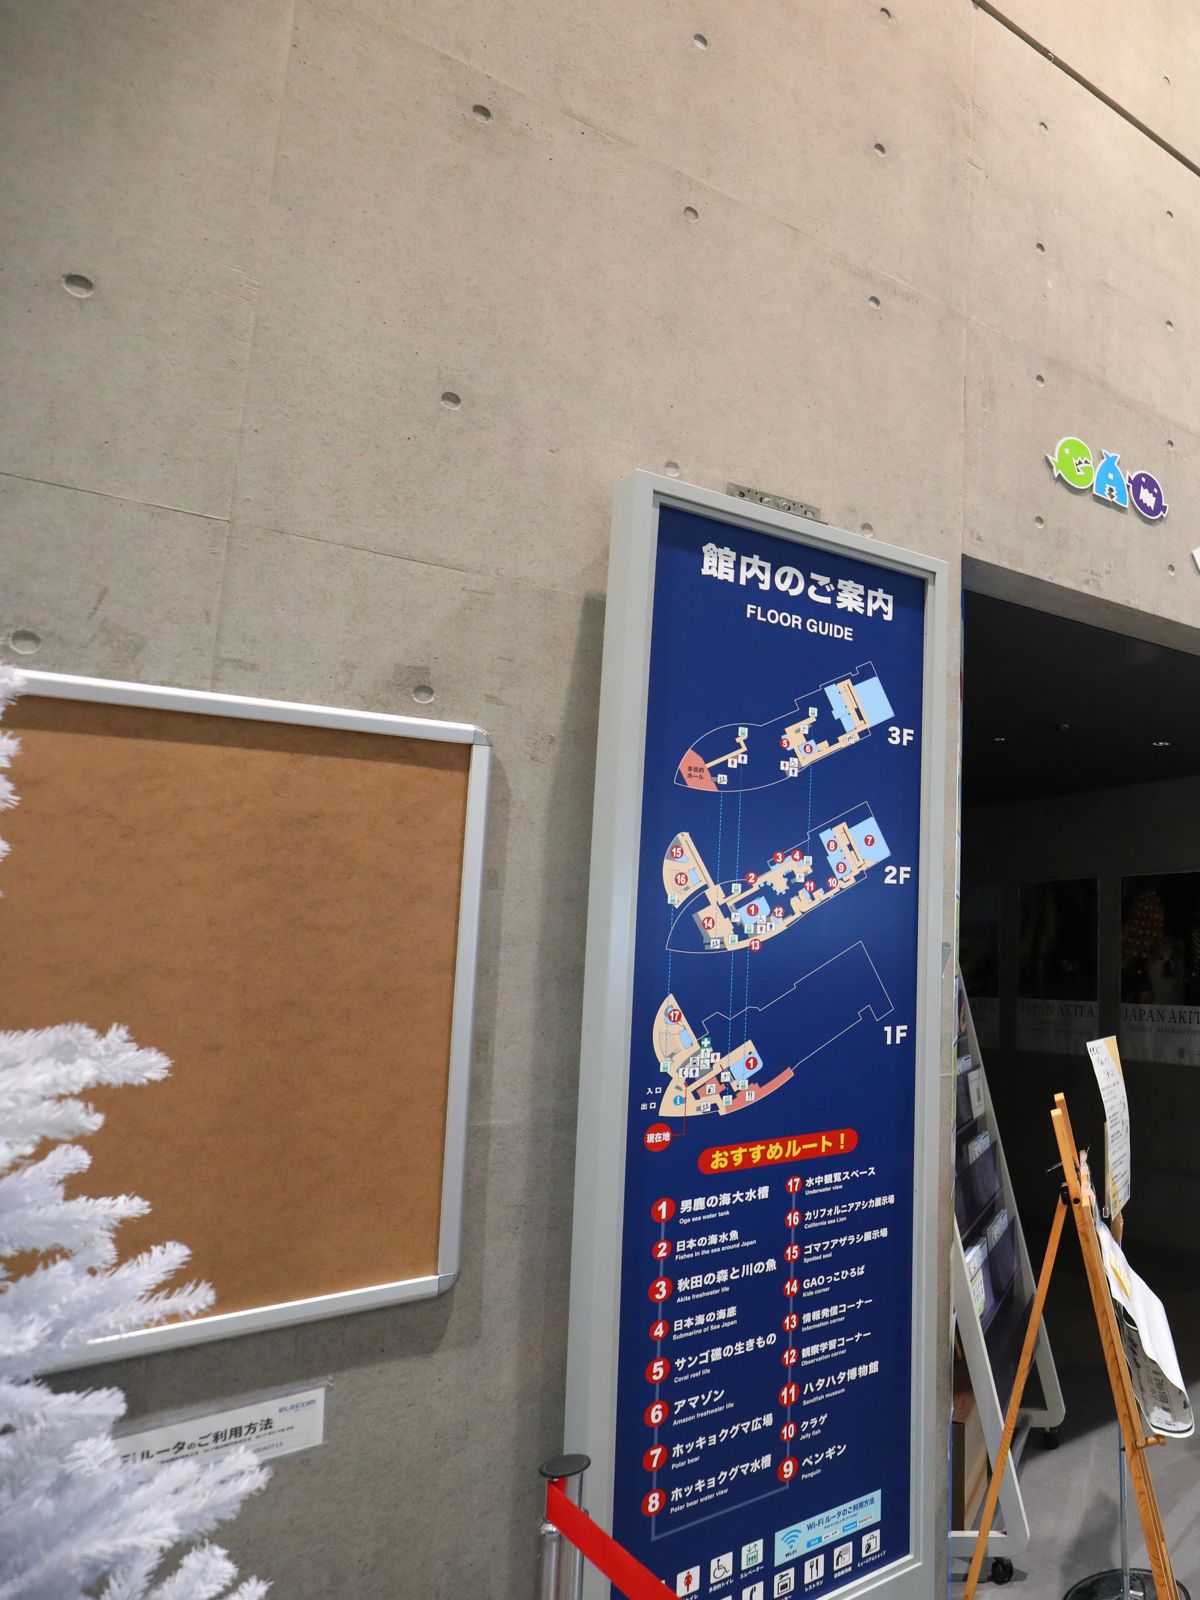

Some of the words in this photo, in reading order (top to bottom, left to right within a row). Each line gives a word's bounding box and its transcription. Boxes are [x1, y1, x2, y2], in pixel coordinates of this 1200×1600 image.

[701, 542, 894, 621] 館内のご案内
[746, 604, 802, 630] FLOOR
[806, 619, 853, 641] GUIDE
[887, 726, 914, 746] 3F
[884, 866, 911, 884] 2F
[1057, 1003, 1095, 1018] AKITA
[1124, 1008, 1165, 1022] JAPAN
[884, 1025, 908, 1045] 1F
[646, 1087, 662, 1095] 入口
[640, 1102, 656, 1110] 出口
[646, 1131, 671, 1144] 現在地
[710, 1134, 846, 1170] おすすめルート！
[787, 1178, 800, 1192] 17
[805, 1167, 876, 1188] 水中観覧スペース
[658, 1201, 667, 1219] 1
[680, 1185, 770, 1214] 男鹿の海大水槽
[805, 1187, 831, 1196] Underwater
[679, 1217, 691, 1225] Oga
[702, 1212, 717, 1220] water
[718, 1210, 730, 1218] tank
[787, 1212, 799, 1226] 16
[804, 1194, 895, 1222] カリフォルニアアシカ展示場
[804, 1221, 827, 1229] California
[657, 1242, 667, 1258] 2
[676, 1230, 739, 1252] 日本の海水魚
[675, 1253, 694, 1261] Fishes
[721, 1243, 740, 1252] around
[741, 1239, 757, 1249] Japan
[786, 1246, 799, 1260] 15
[804, 1227, 888, 1255] ゴマフアザラシ展示場
[803, 1254, 822, 1264] Spotted
[655, 1280, 667, 1300] 3
[677, 1258, 777, 1293] 秋田の森と川の魚
[785, 1280, 798, 1295] 14
[803, 1264, 866, 1289] GAOっこひろば
[677, 1295, 691, 1303] Akita
[691, 1289, 720, 1300] freshwater
[814, 1286, 831, 1295] corner
[654, 1322, 664, 1338] 4
[673, 1306, 737, 1332] 日本海の海底
[784, 1315, 797, 1330] 13
[802, 1298, 873, 1324] 情報発信コーナー
[801, 1320, 829, 1332] Information
[830, 1316, 845, 1325] corner
[672, 1329, 702, 1341] Submarine
[721, 1319, 737, 1330] Japan
[652, 1361, 664, 1381] 5
[675, 1333, 777, 1372] サンゴ礁の生きもの
[783, 1349, 796, 1365] 12
[801, 1331, 872, 1359] 観察学習コーナー
[801, 1354, 830, 1367] Observation
[831, 1349, 847, 1358] corner
[674, 1374, 689, 1384] Coral
[690, 1371, 701, 1379] reef
[702, 1368, 711, 1376] life
[781, 1385, 796, 1405] 11
[803, 1361, 880, 1395] ハタハタ博物館
[278, 1399, 316, 1413] ELECOM
[651, 1404, 663, 1424] 6
[674, 1389, 725, 1415] アマゾン
[803, 1395, 825, 1406] Sandfish
[825, 1387, 846, 1399] museum
[672, 1414, 695, 1426] Amazon
[696, 1406, 725, 1419] freshwater
[725, 1402, 734, 1410] life
[782, 1424, 795, 1440] 10
[800, 1413, 828, 1432] クラゲ
[799, 1431, 812, 1441] Jelly
[812, 1429, 821, 1437] fish
[650, 1448, 662, 1468] 7
[672, 1413, 773, 1458] ホッキョクグマ広場
[671, 1460, 686, 1470] Polar
[687, 1456, 700, 1465] bear
[783, 1460, 794, 1479] 9
[802, 1444, 847, 1468] ペンギン
[647, 1492, 660, 1513] 8
[671, 1454, 772, 1502] ホッキョクグマ水槽
[801, 1468, 822, 1481] Penguin
[670, 1504, 685, 1514] Polar
[686, 1499, 699, 1508] bear
[700, 1493, 715, 1503] water
[716, 1488, 728, 1497] view
[806, 1520, 824, 1532] Wi-Fi
[805, 1580, 824, 1592] レストラン
